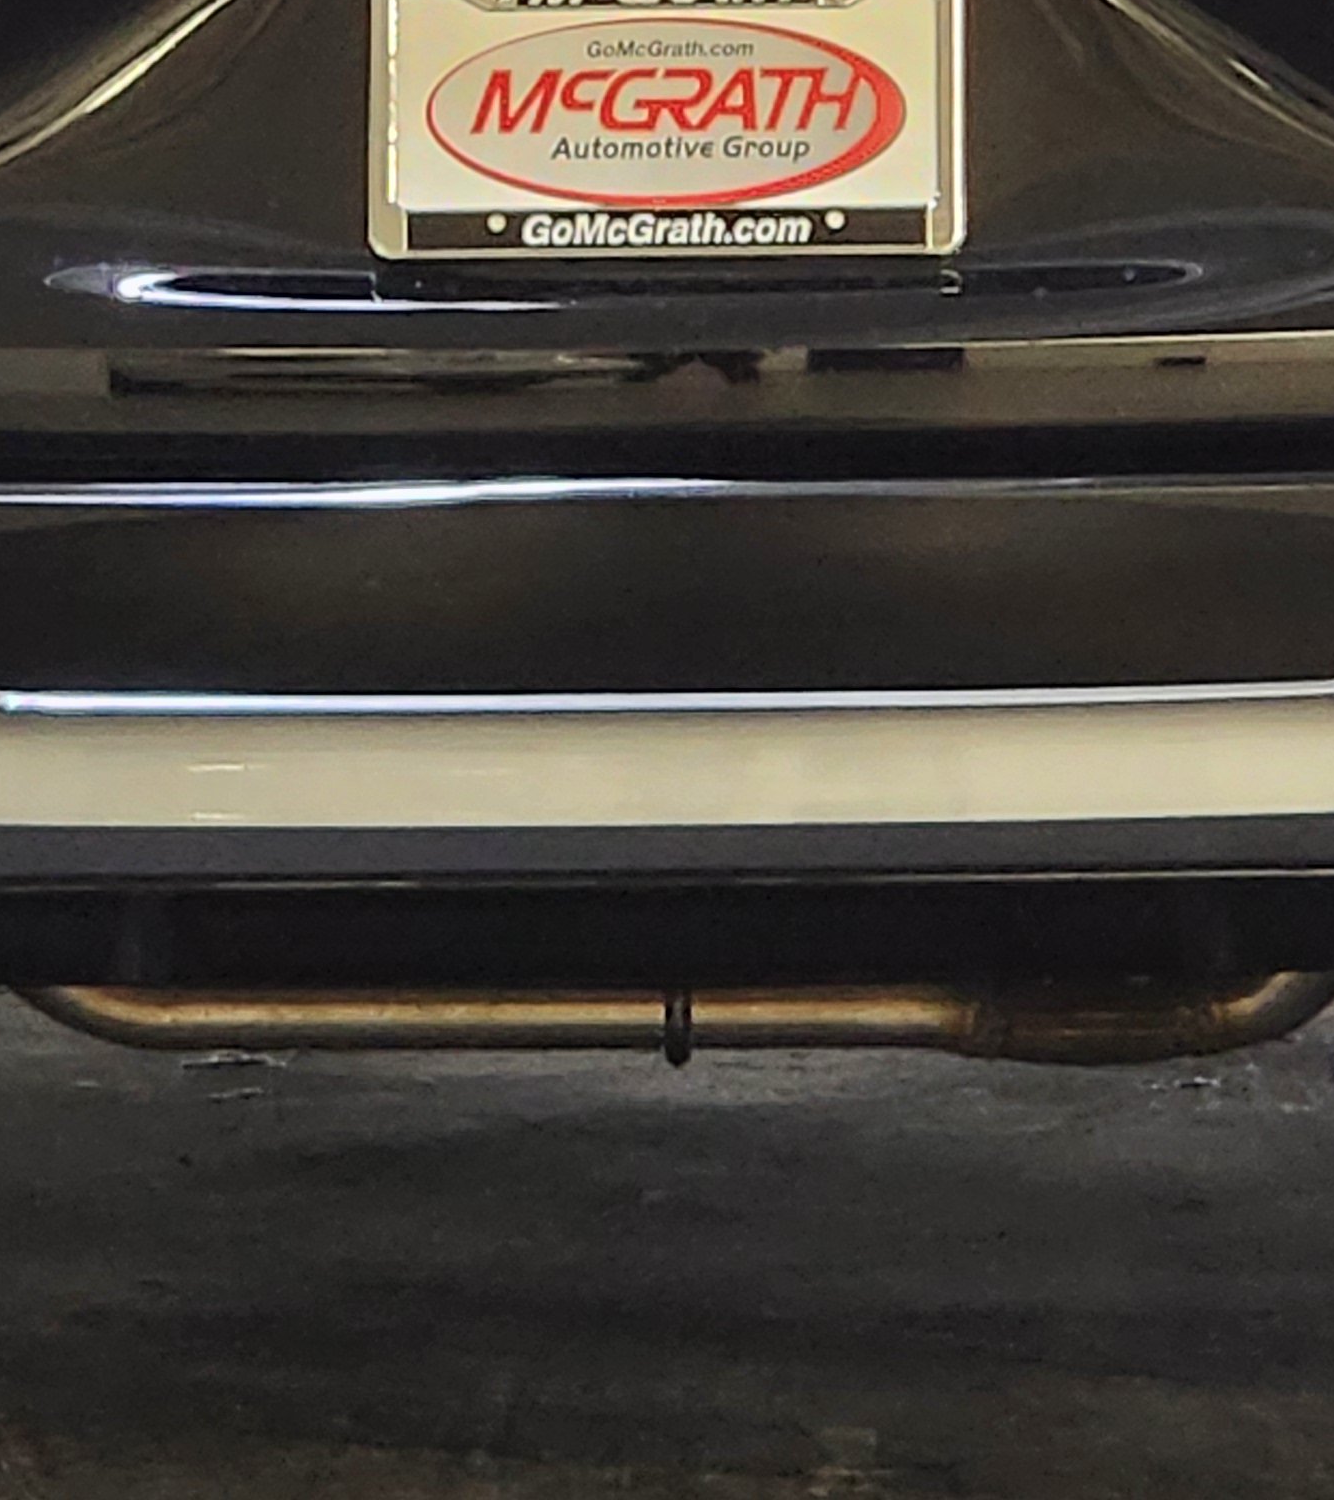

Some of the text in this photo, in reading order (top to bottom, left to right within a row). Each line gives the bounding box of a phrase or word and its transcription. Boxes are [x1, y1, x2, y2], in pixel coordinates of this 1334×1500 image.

[587, 40, 755, 59] GoMcGrath.com
[551, 135, 811, 163] Automotive Group
[521, 212, 813, 247] GoMcGrath.com
